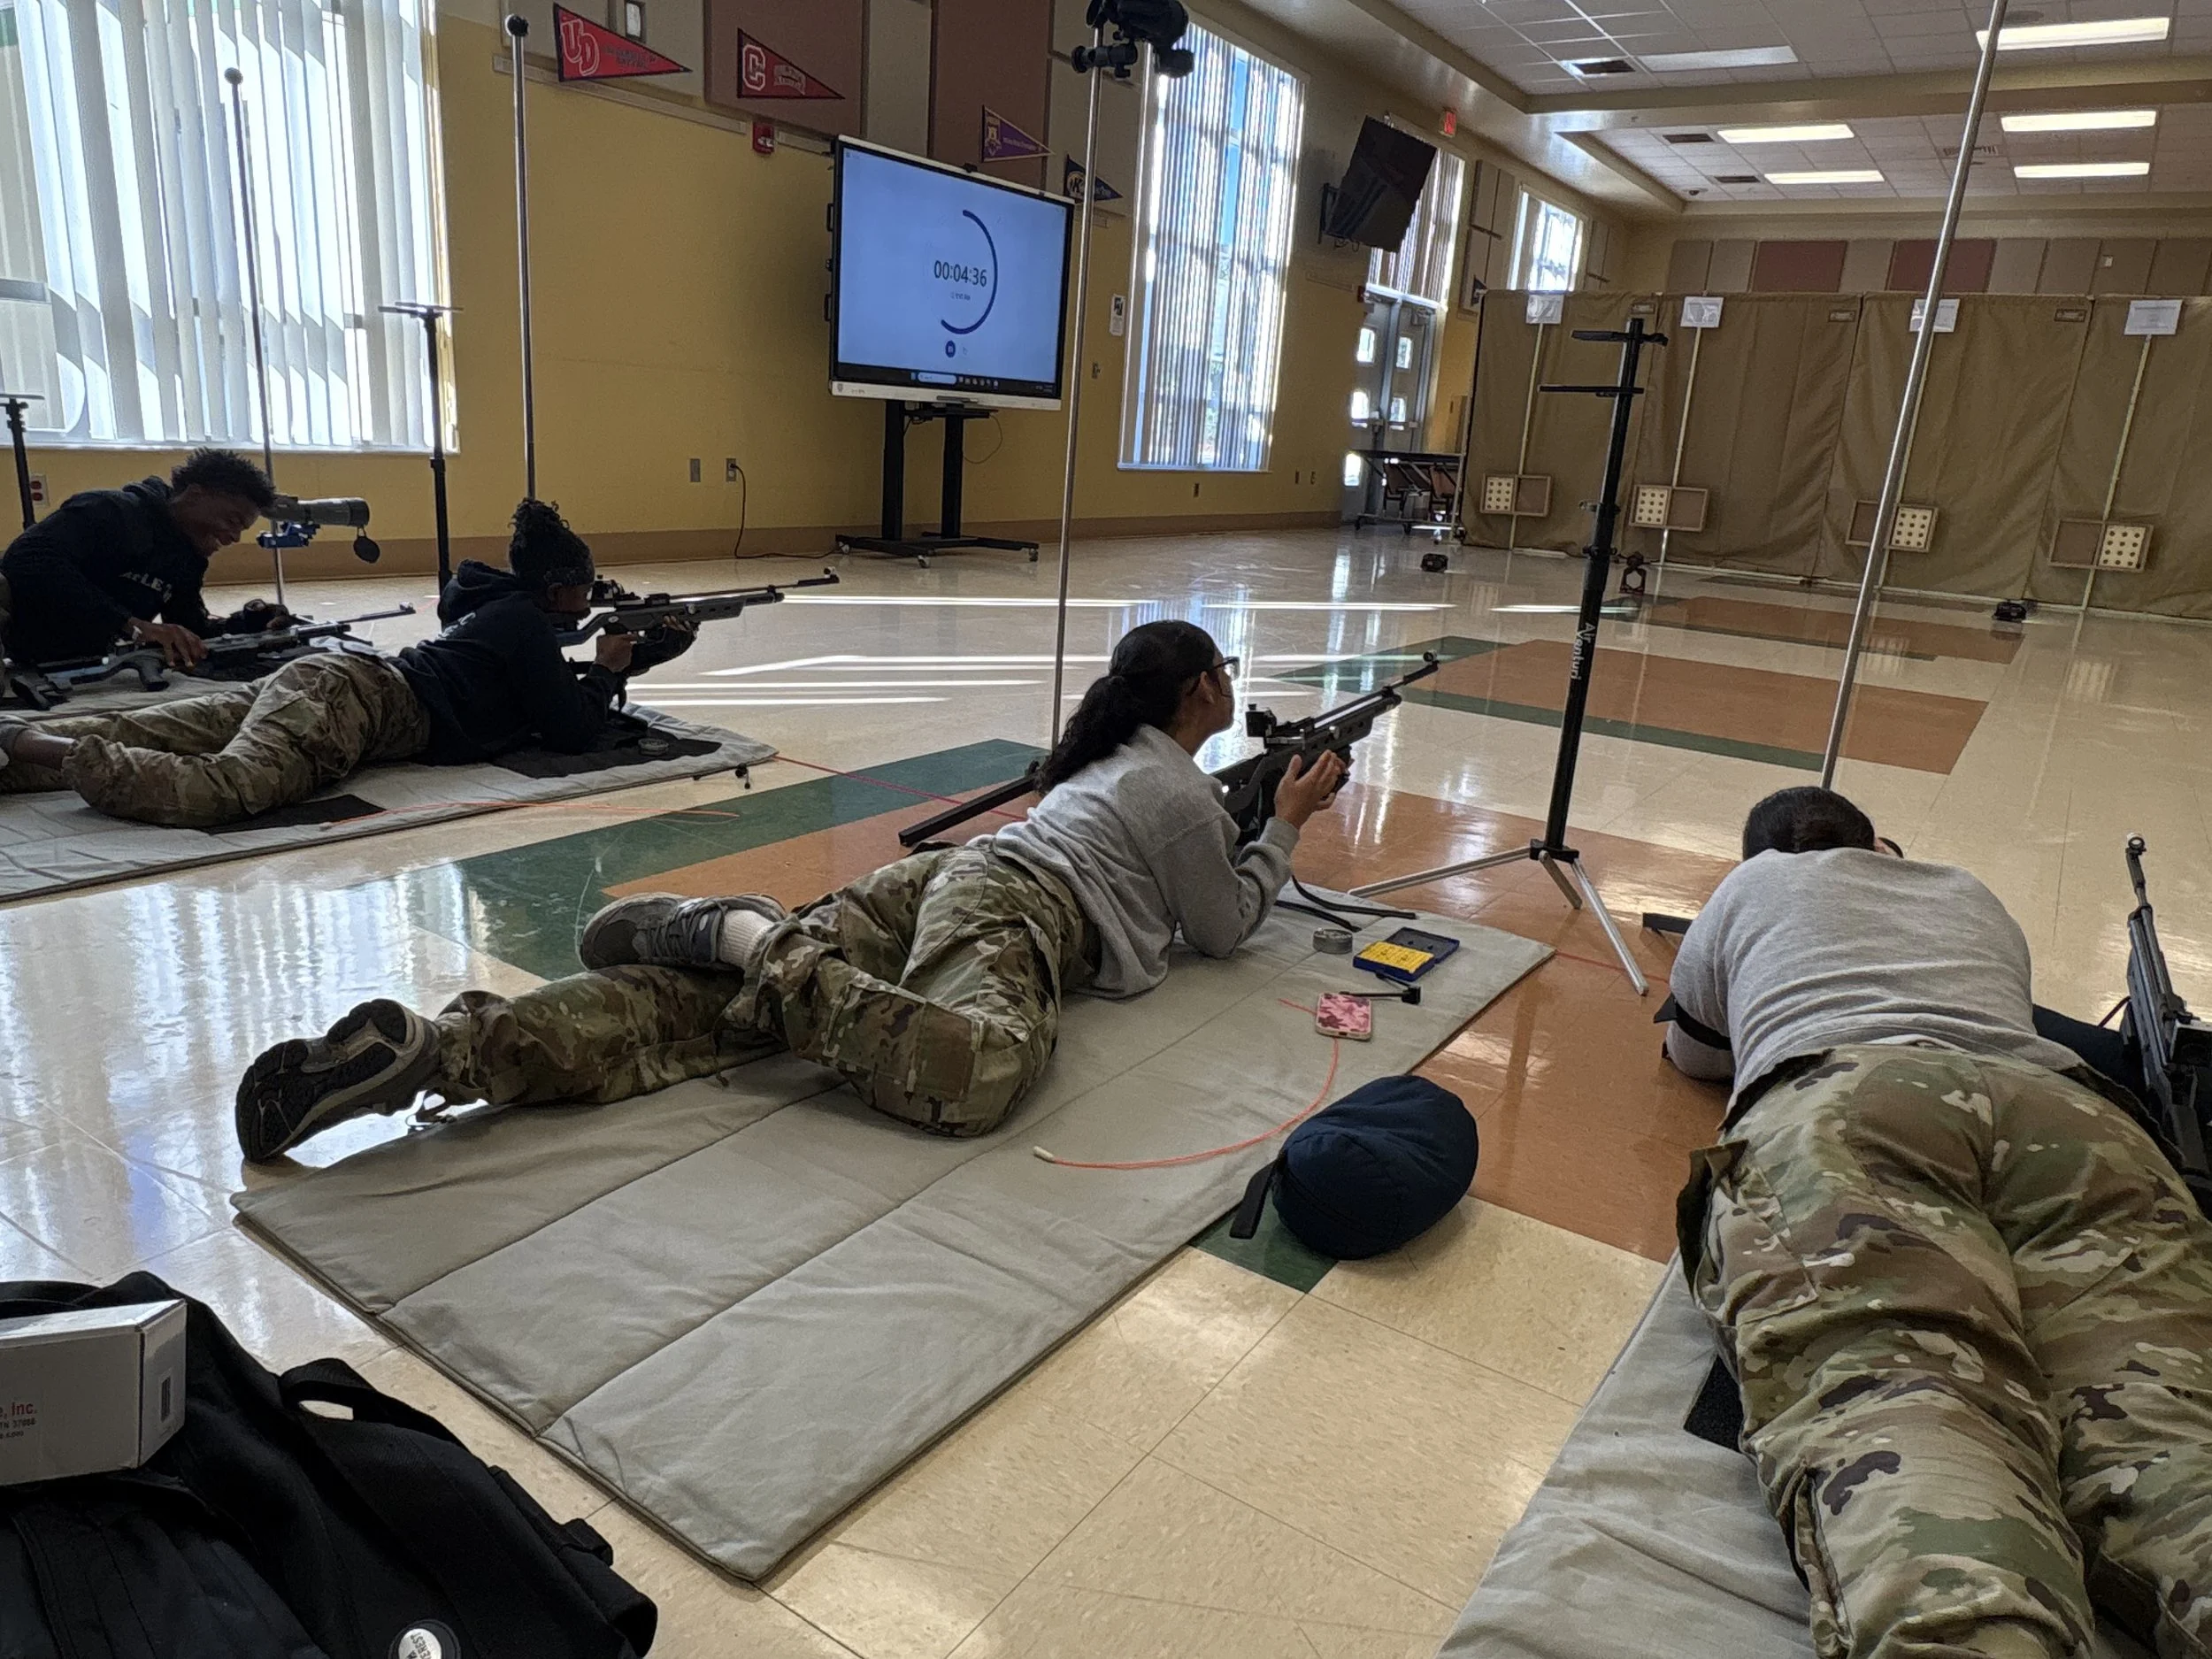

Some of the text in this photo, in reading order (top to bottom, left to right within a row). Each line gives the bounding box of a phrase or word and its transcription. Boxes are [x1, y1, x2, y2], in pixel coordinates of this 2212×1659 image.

[561, 19, 600, 77] UD
[742, 43, 765, 92] C
[933, 259, 987, 288] 00:04:36
[1582, 622, 1596, 644] Air
[1570, 629, 1585, 680] Venturi
[12, 1402, 38, 1416] Inc.
